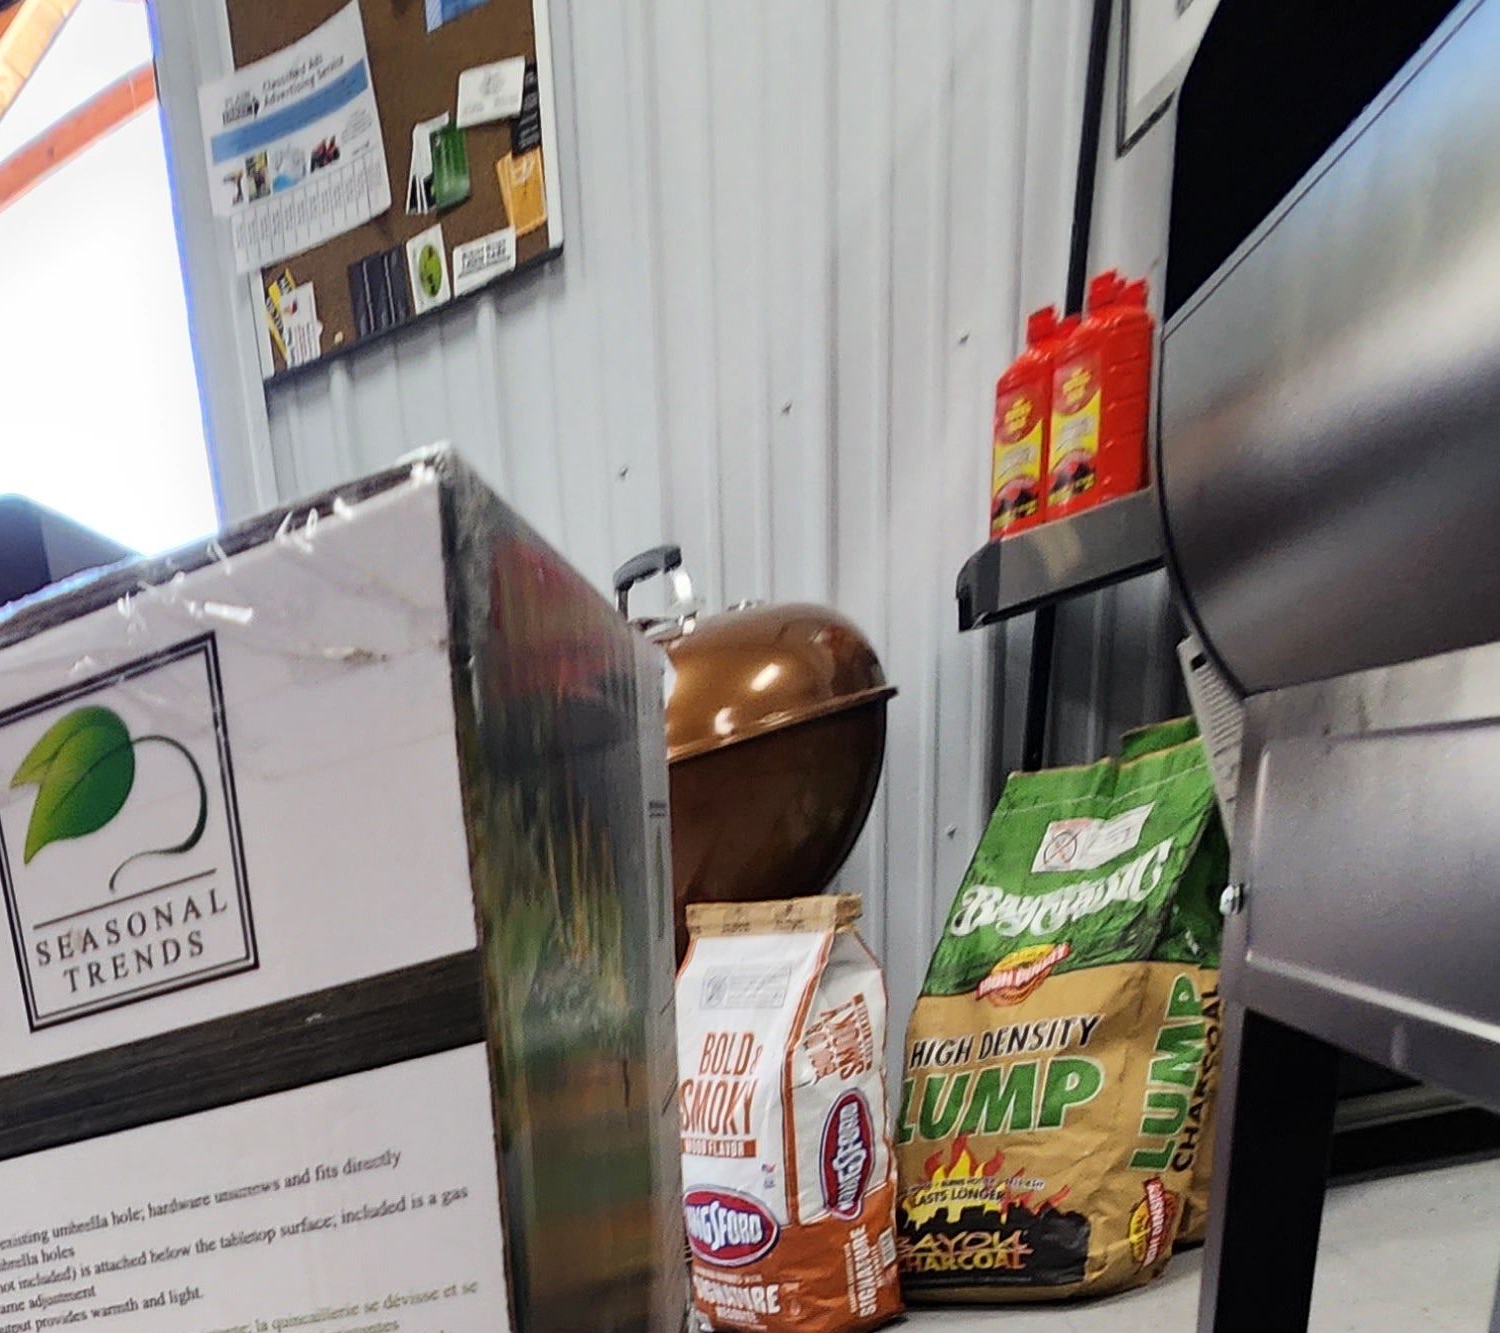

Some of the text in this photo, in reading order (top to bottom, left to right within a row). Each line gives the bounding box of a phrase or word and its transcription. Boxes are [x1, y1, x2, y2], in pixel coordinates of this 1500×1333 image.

[35, 887, 228, 967] SEASONAL
[63, 930, 205, 994] TRENDS
[699, 1032, 754, 1076] BOLD
[908, 1035, 975, 1070] HIGH
[977, 1013, 1105, 1061] DENSITY
[1128, 972, 1208, 1171] LUMP
[679, 1078, 759, 1135] SMOKY
[898, 1055, 1105, 1146] LUMP
[833, 1102, 868, 1212] KINGSFORD
[50, 1213, 108, 1238] umbrella
[146, 1190, 211, 1216] hardware
[282, 1168, 312, 1187] and
[312, 1162, 339, 1180] fits
[340, 1149, 402, 1178] directly
[951, 1187, 1005, 1202] LONGER
[16, 1265, 78, 1293] included)
[92, 1250, 148, 1274] attached
[147, 1241, 191, 1262] below
[193, 1236, 216, 1253] the
[218, 1224, 277, 1252] tabletop
[339, 1197, 408, 1223] included
[440, 1188, 469, 1207] gas
[39, 1243, 75, 1262] holes
[850, 1225, 878, 1317] SIGNATURE
[901, 1250, 1027, 1272] HARCOAL
[33, 1307, 89, 1333] provides
[89, 1298, 139, 1319] warmth
[140, 1293, 167, 1310] and
